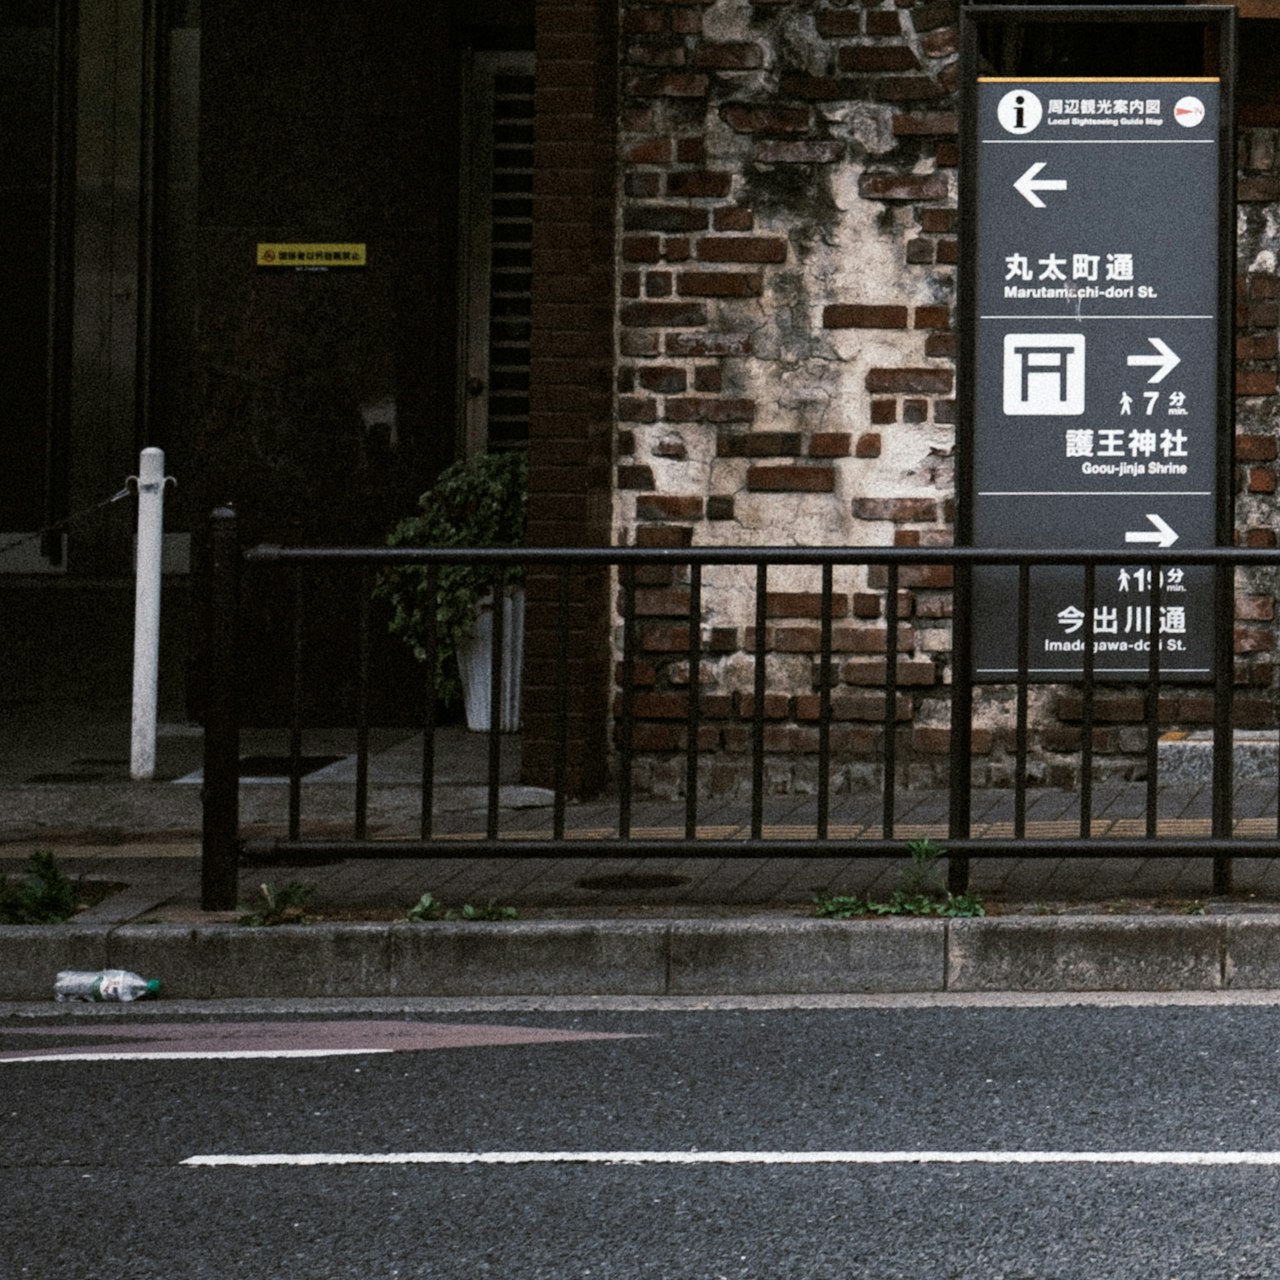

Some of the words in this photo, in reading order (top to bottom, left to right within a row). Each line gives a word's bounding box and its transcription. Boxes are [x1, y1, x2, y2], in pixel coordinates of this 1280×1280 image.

[1048, 99, 1161, 115] 周辺観光案内図
[1004, 252, 1135, 281] 丸太町通
[1137, 284, 1159, 299] St.
[1142, 391, 1160, 416] 7
[1168, 391, 1187, 407] 分
[1167, 406, 1189, 416] min.
[1065, 428, 1189, 458] 護王神社
[1081, 461, 1146, 477] Goou-jinja
[1147, 461, 1188, 475] Shrine
[1166, 567, 1185, 584] 分
[1166, 583, 1188, 592] min.
[1056, 605, 1187, 635] 今出川通
[1166, 638, 1187, 651] St.
